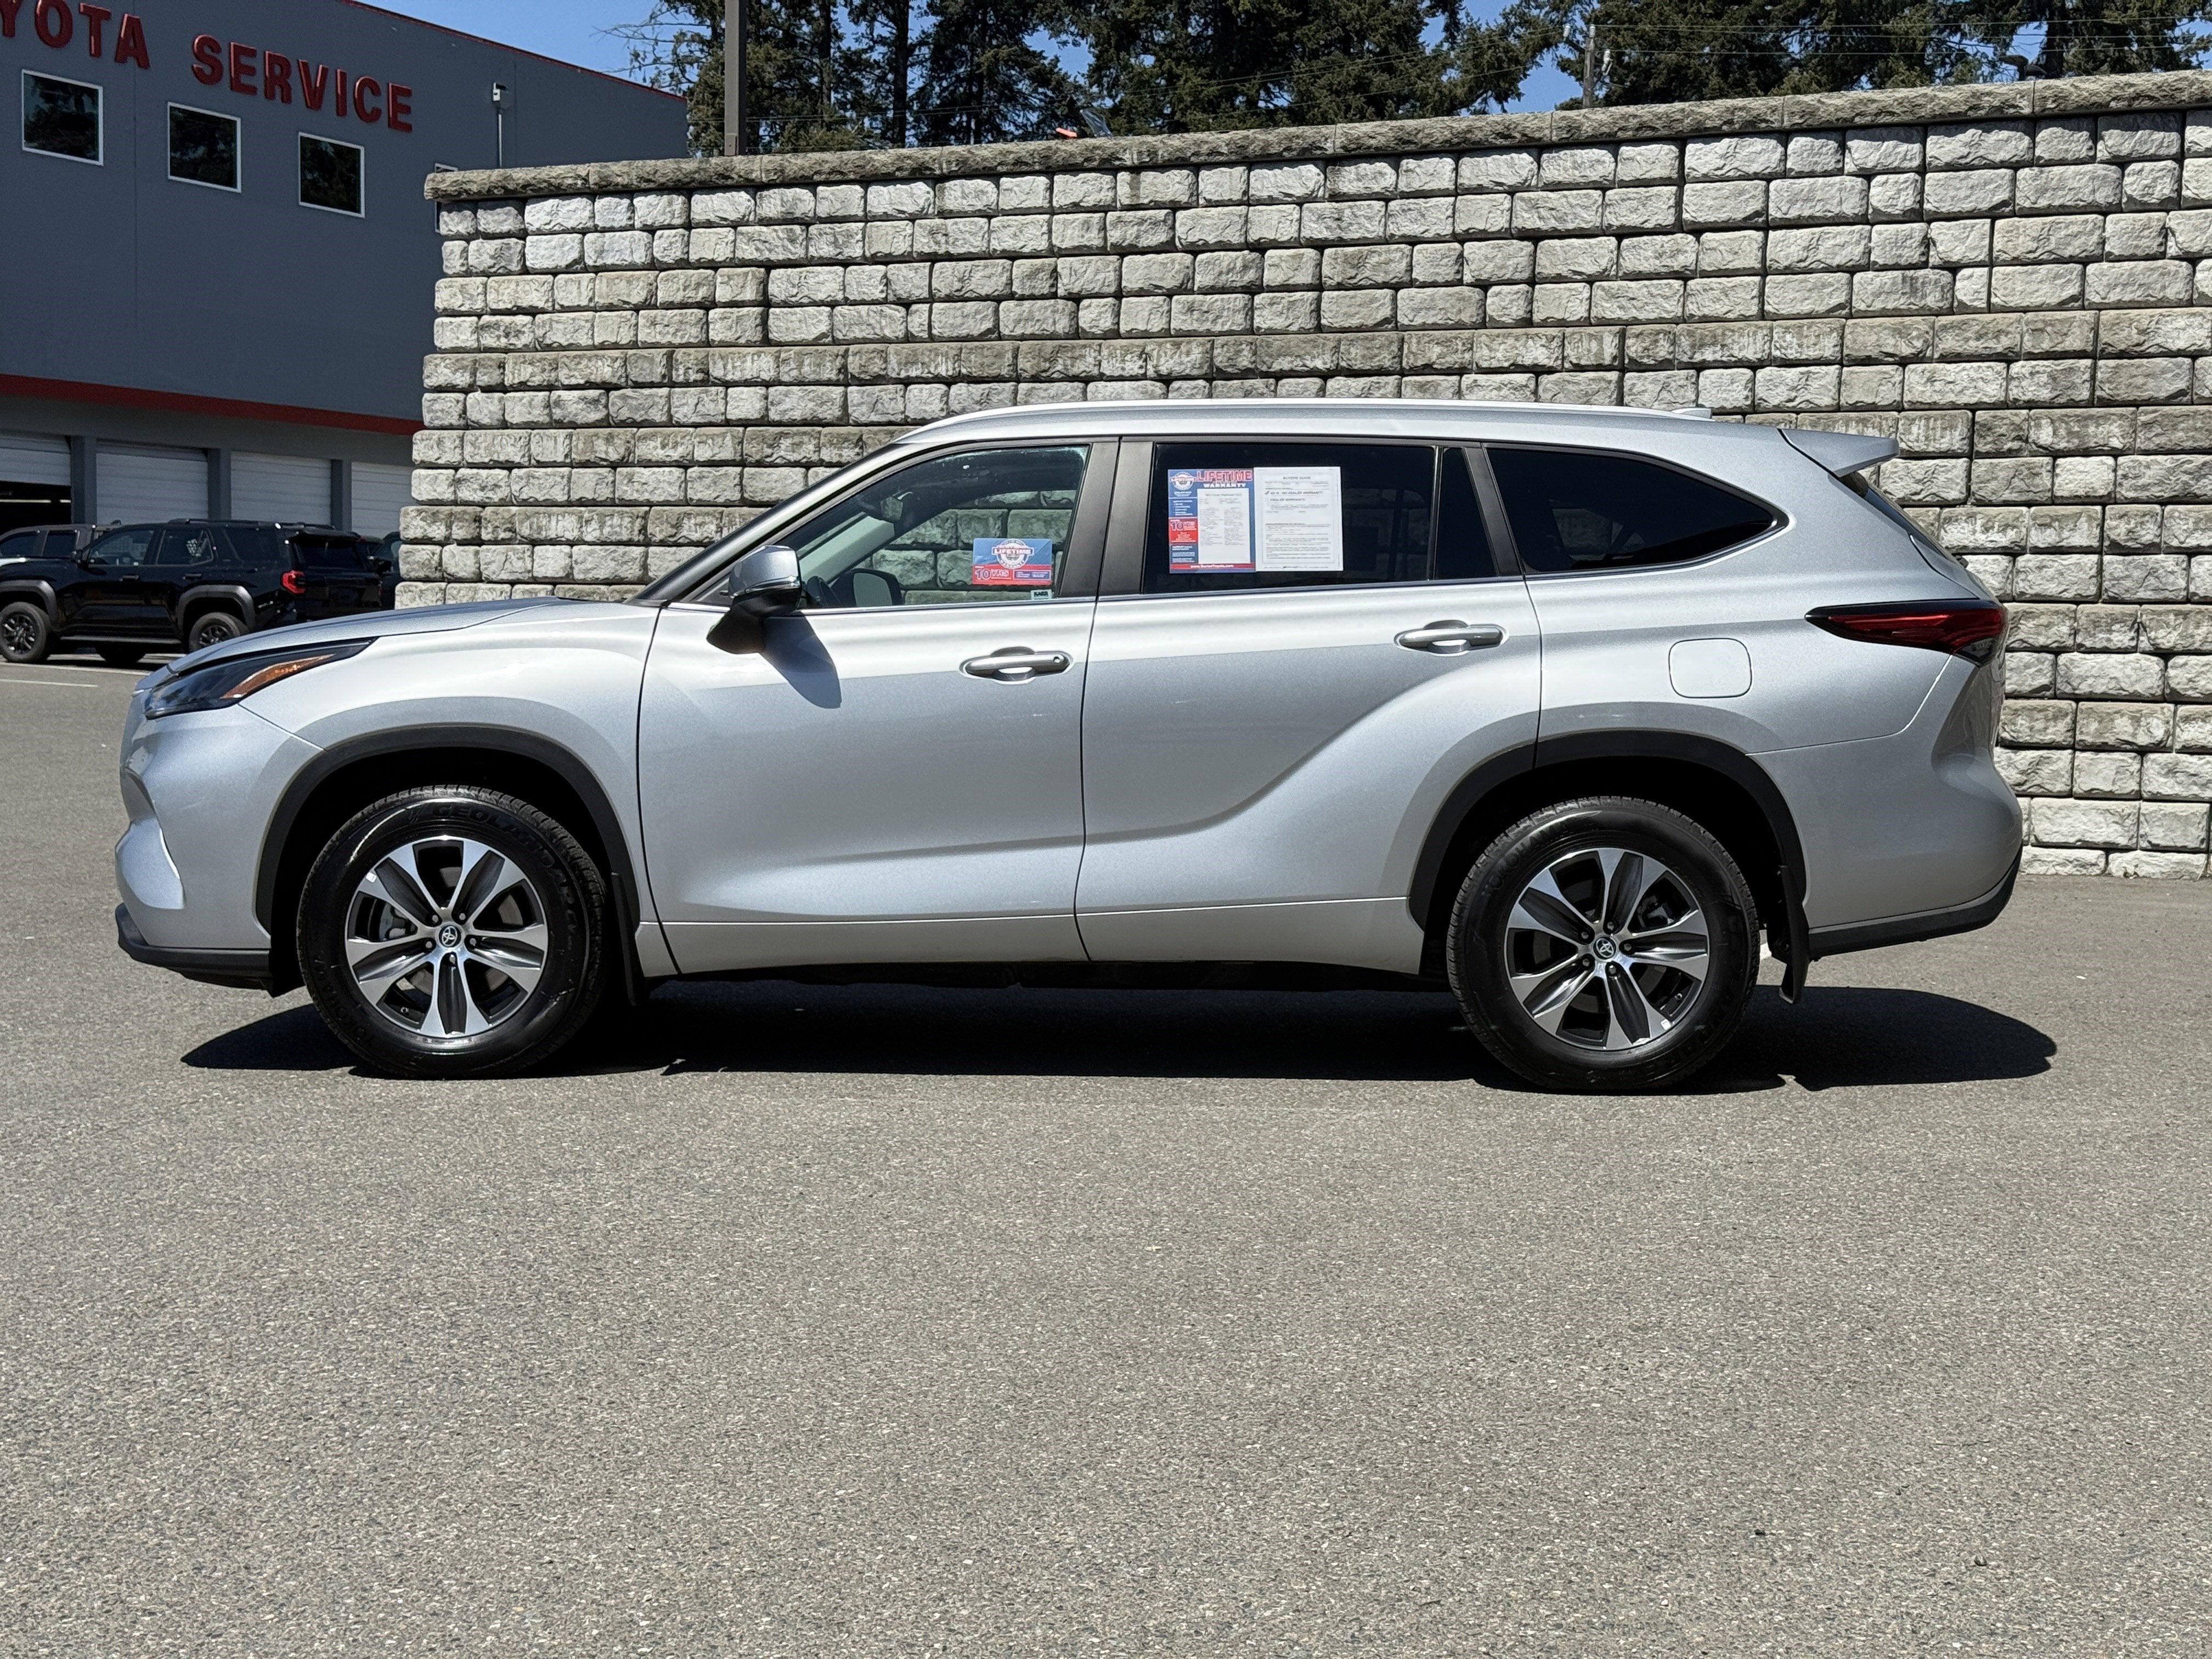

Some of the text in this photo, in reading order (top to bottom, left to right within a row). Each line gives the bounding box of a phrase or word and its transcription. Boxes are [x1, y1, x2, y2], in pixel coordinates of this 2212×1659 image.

[193, 34, 413, 133] SERVICE
[1197, 470, 1253, 482] LIFETIME
[974, 569, 991, 580] 10
